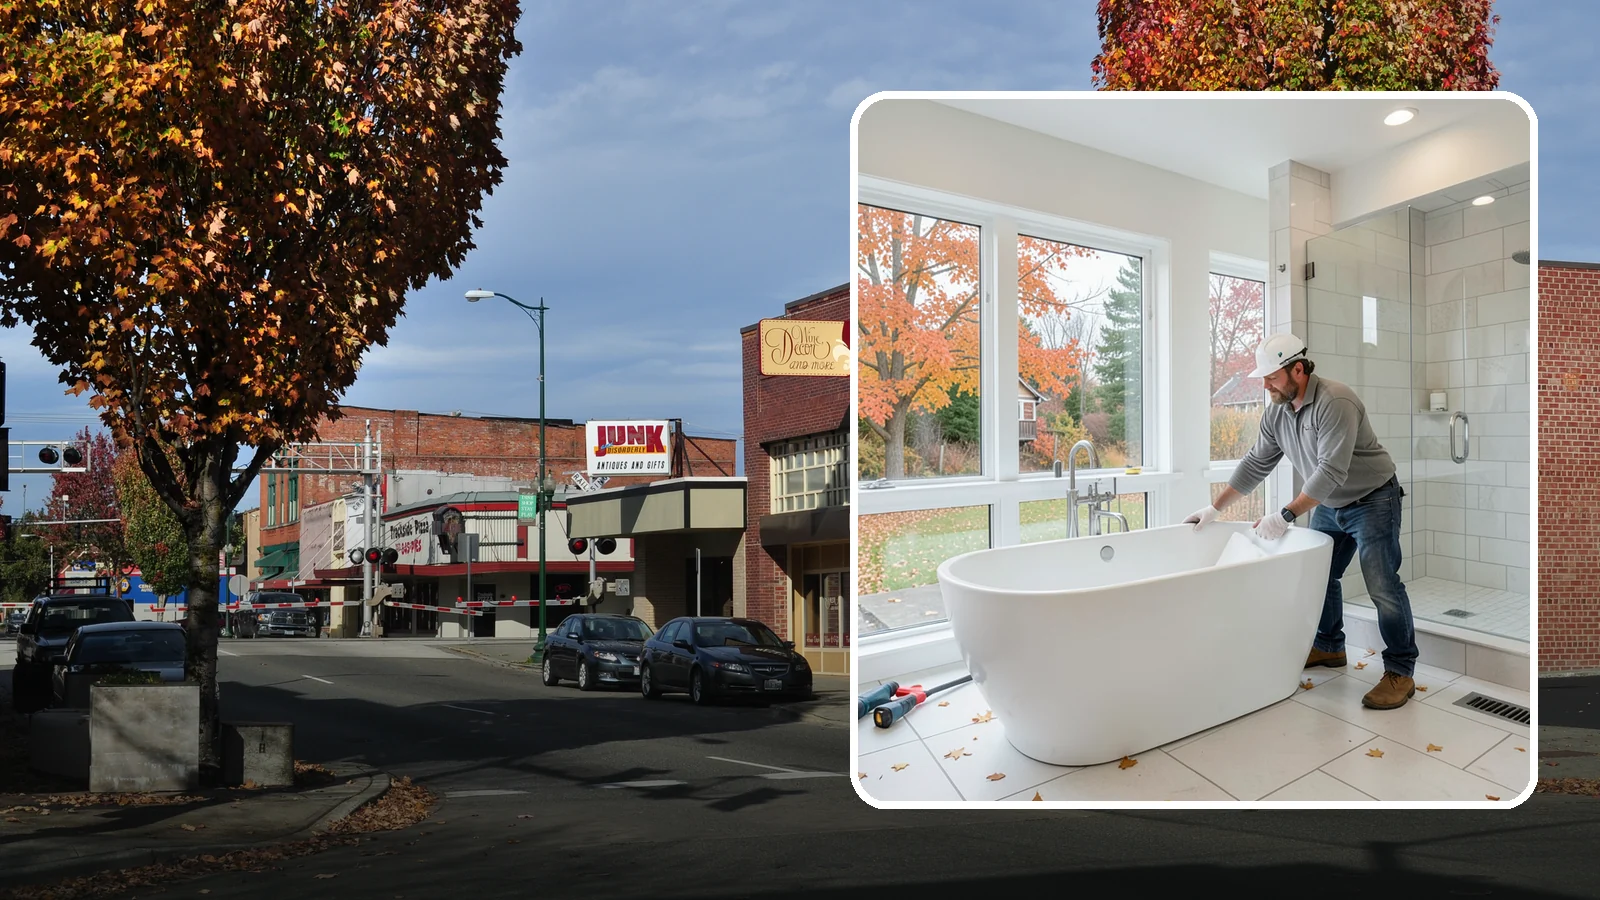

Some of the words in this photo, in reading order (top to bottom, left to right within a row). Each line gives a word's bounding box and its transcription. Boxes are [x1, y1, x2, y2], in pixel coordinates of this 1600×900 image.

[765, 327, 831, 365] Decor
[595, 425, 665, 457] JUNK
[607, 446, 646, 454] DISORDERLY
[597, 461, 628, 470] ANTIQUES
[631, 461, 644, 470] AND
[647, 460, 665, 469] GIFTS
[573, 473, 588, 491] RAIL
[590, 476, 609, 491] SING
[390, 521, 413, 540] Trackside
[414, 519, 429, 535] Pizza
